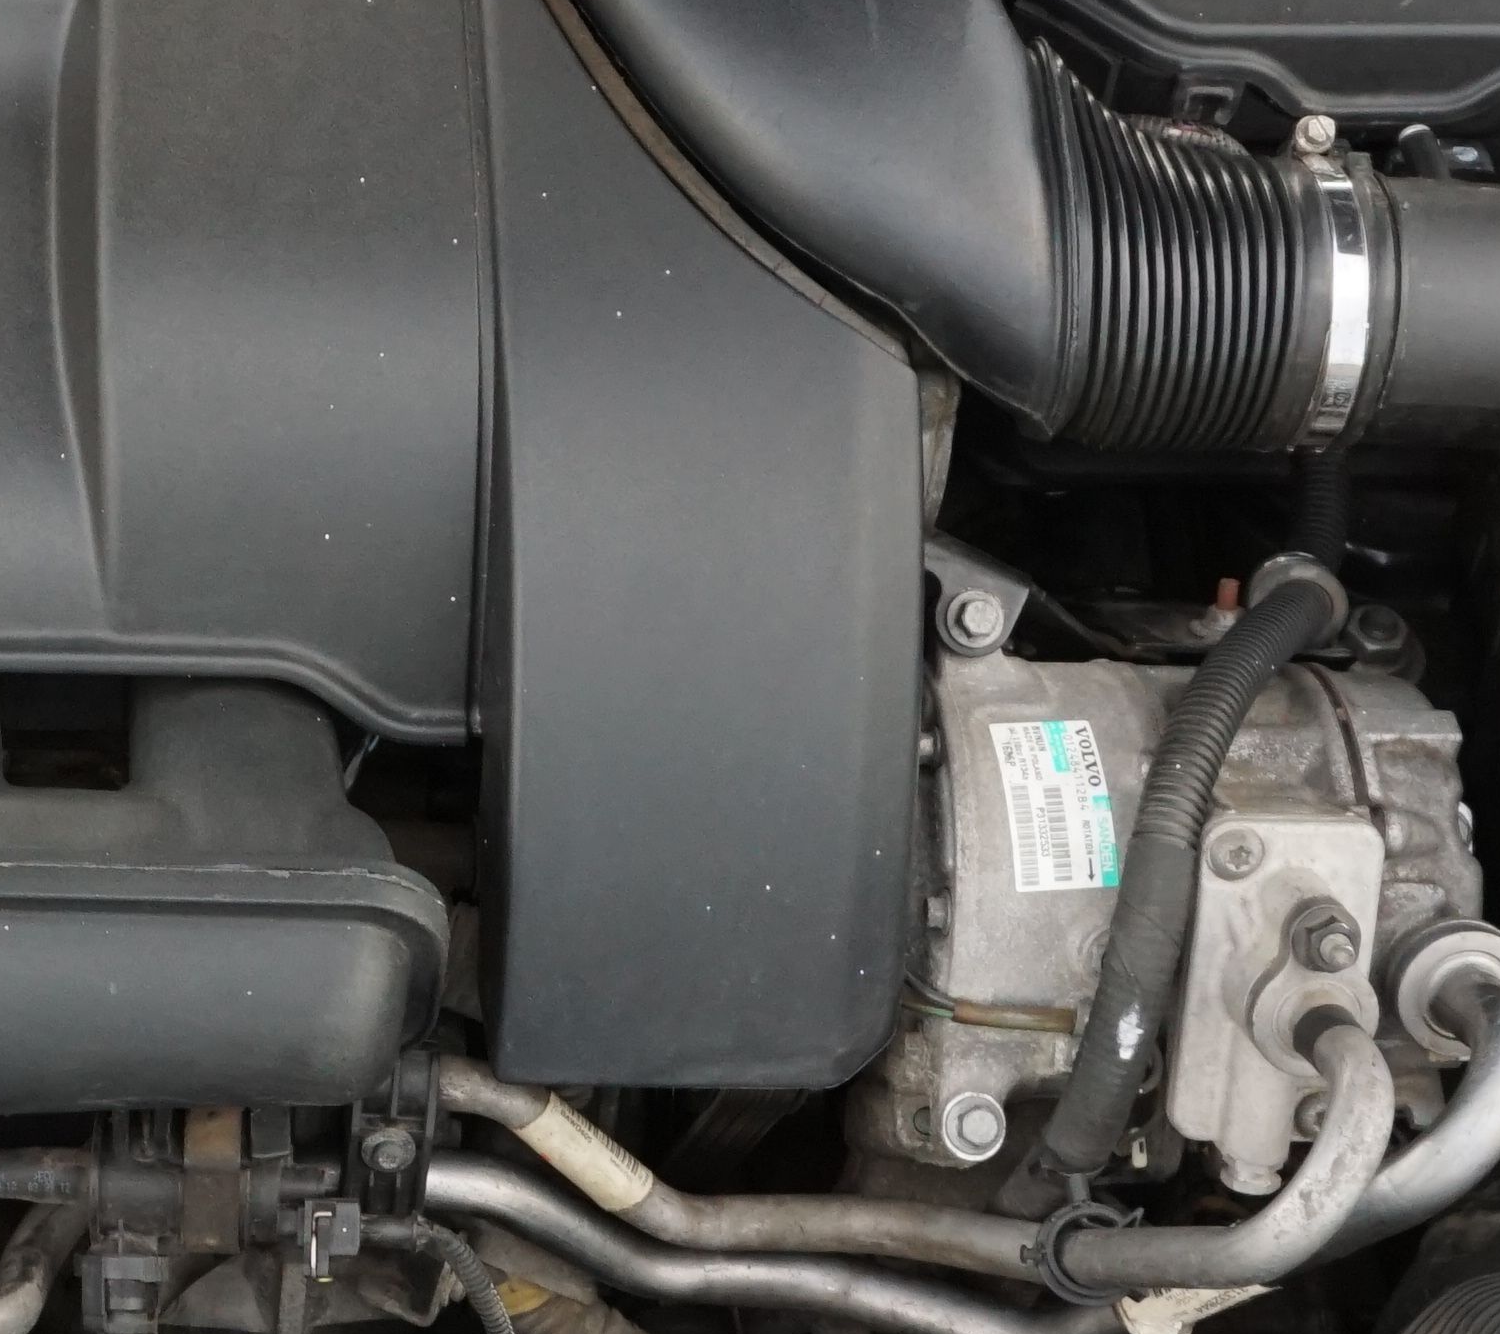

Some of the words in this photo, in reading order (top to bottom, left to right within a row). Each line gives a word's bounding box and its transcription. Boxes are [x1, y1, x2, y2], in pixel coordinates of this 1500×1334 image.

[1075, 725, 1101, 787] VOLVO
[1098, 818, 1114, 872] SANDEN
[1081, 819, 1093, 856] ROTATION
